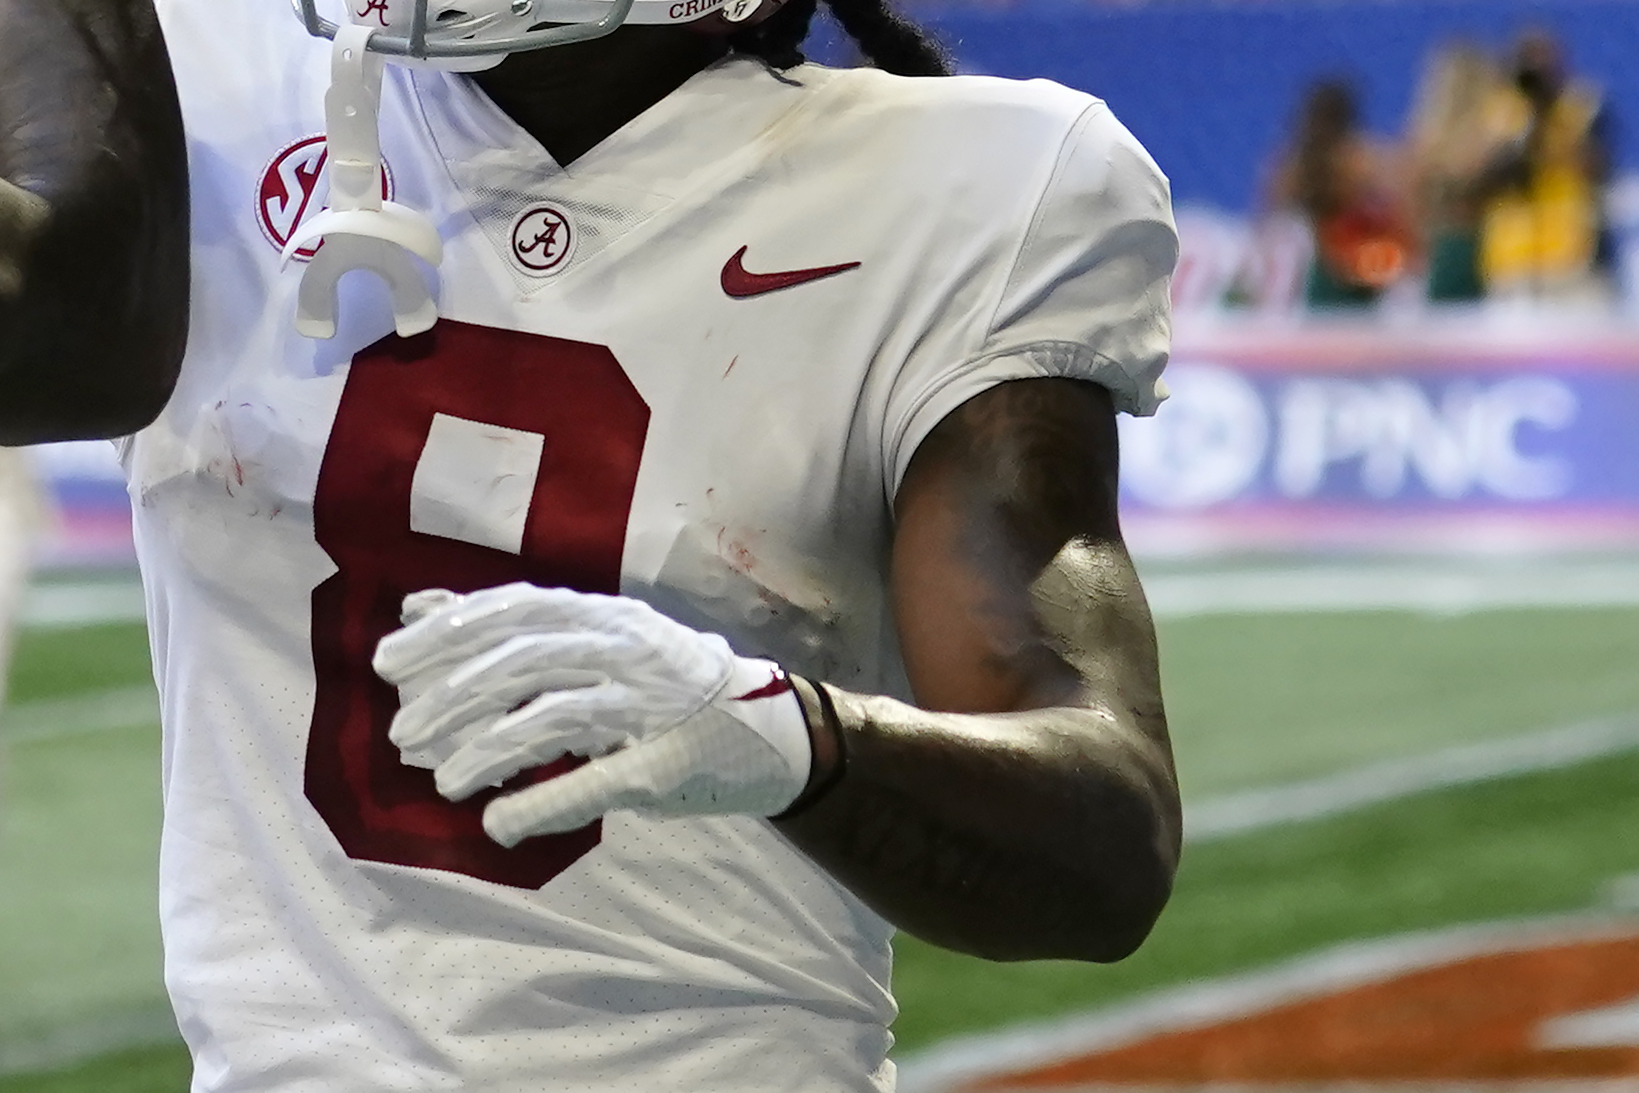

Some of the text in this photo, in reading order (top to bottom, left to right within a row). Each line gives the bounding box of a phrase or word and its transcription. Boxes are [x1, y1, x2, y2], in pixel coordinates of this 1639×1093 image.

[519, 217, 562, 258] A
[1274, 375, 1576, 500] PNC
[304, 317, 651, 891] 8
